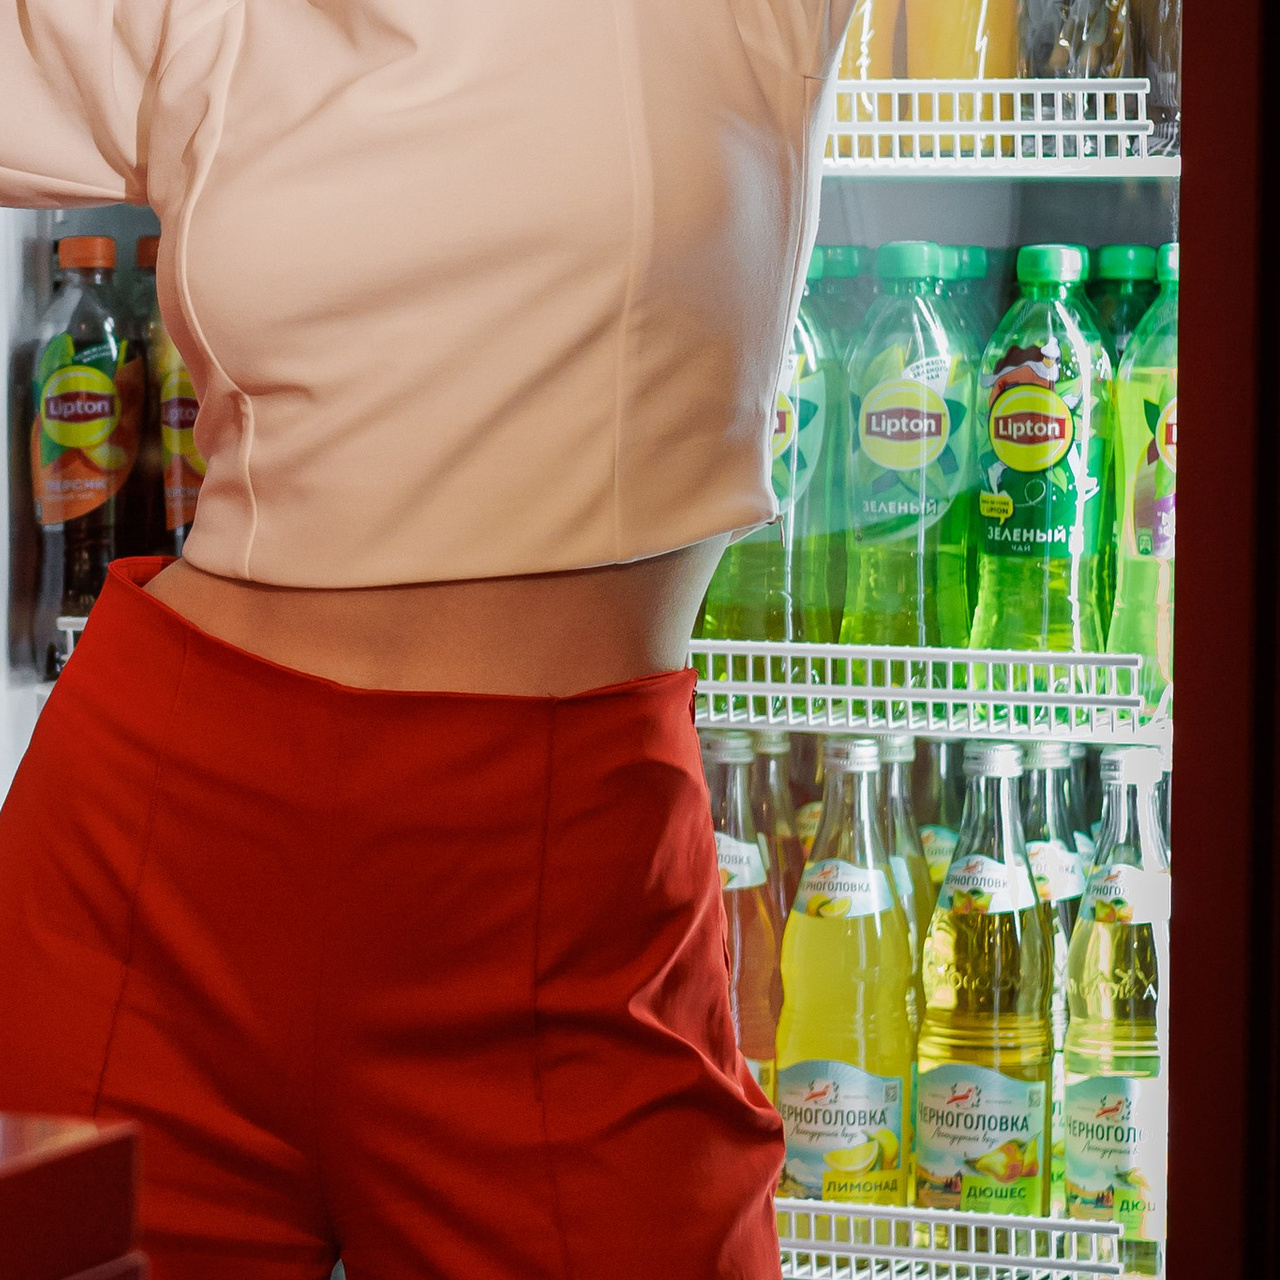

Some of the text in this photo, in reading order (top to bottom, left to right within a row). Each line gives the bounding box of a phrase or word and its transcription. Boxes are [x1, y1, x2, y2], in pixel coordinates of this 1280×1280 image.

[48, 397, 110, 418] Lipton
[870, 414, 936, 436] Lipton
[997, 416, 1061, 439] Lipton
[862, 498, 938, 516] ЗЕЛЕНЫЙ
[987, 524, 1066, 544] ЗЕЛЕНЫЙ
[1010, 543, 1031, 553] ЧАЙ
[777, 1100, 888, 1127] ЧЕРНОГОЛОВКА
[918, 1100, 1029, 1133] ЧЕРНОГОЛОВКА
[826, 1178, 899, 1194] ЛИМОНАД
[966, 1185, 1028, 1199] ДЮШЕС
